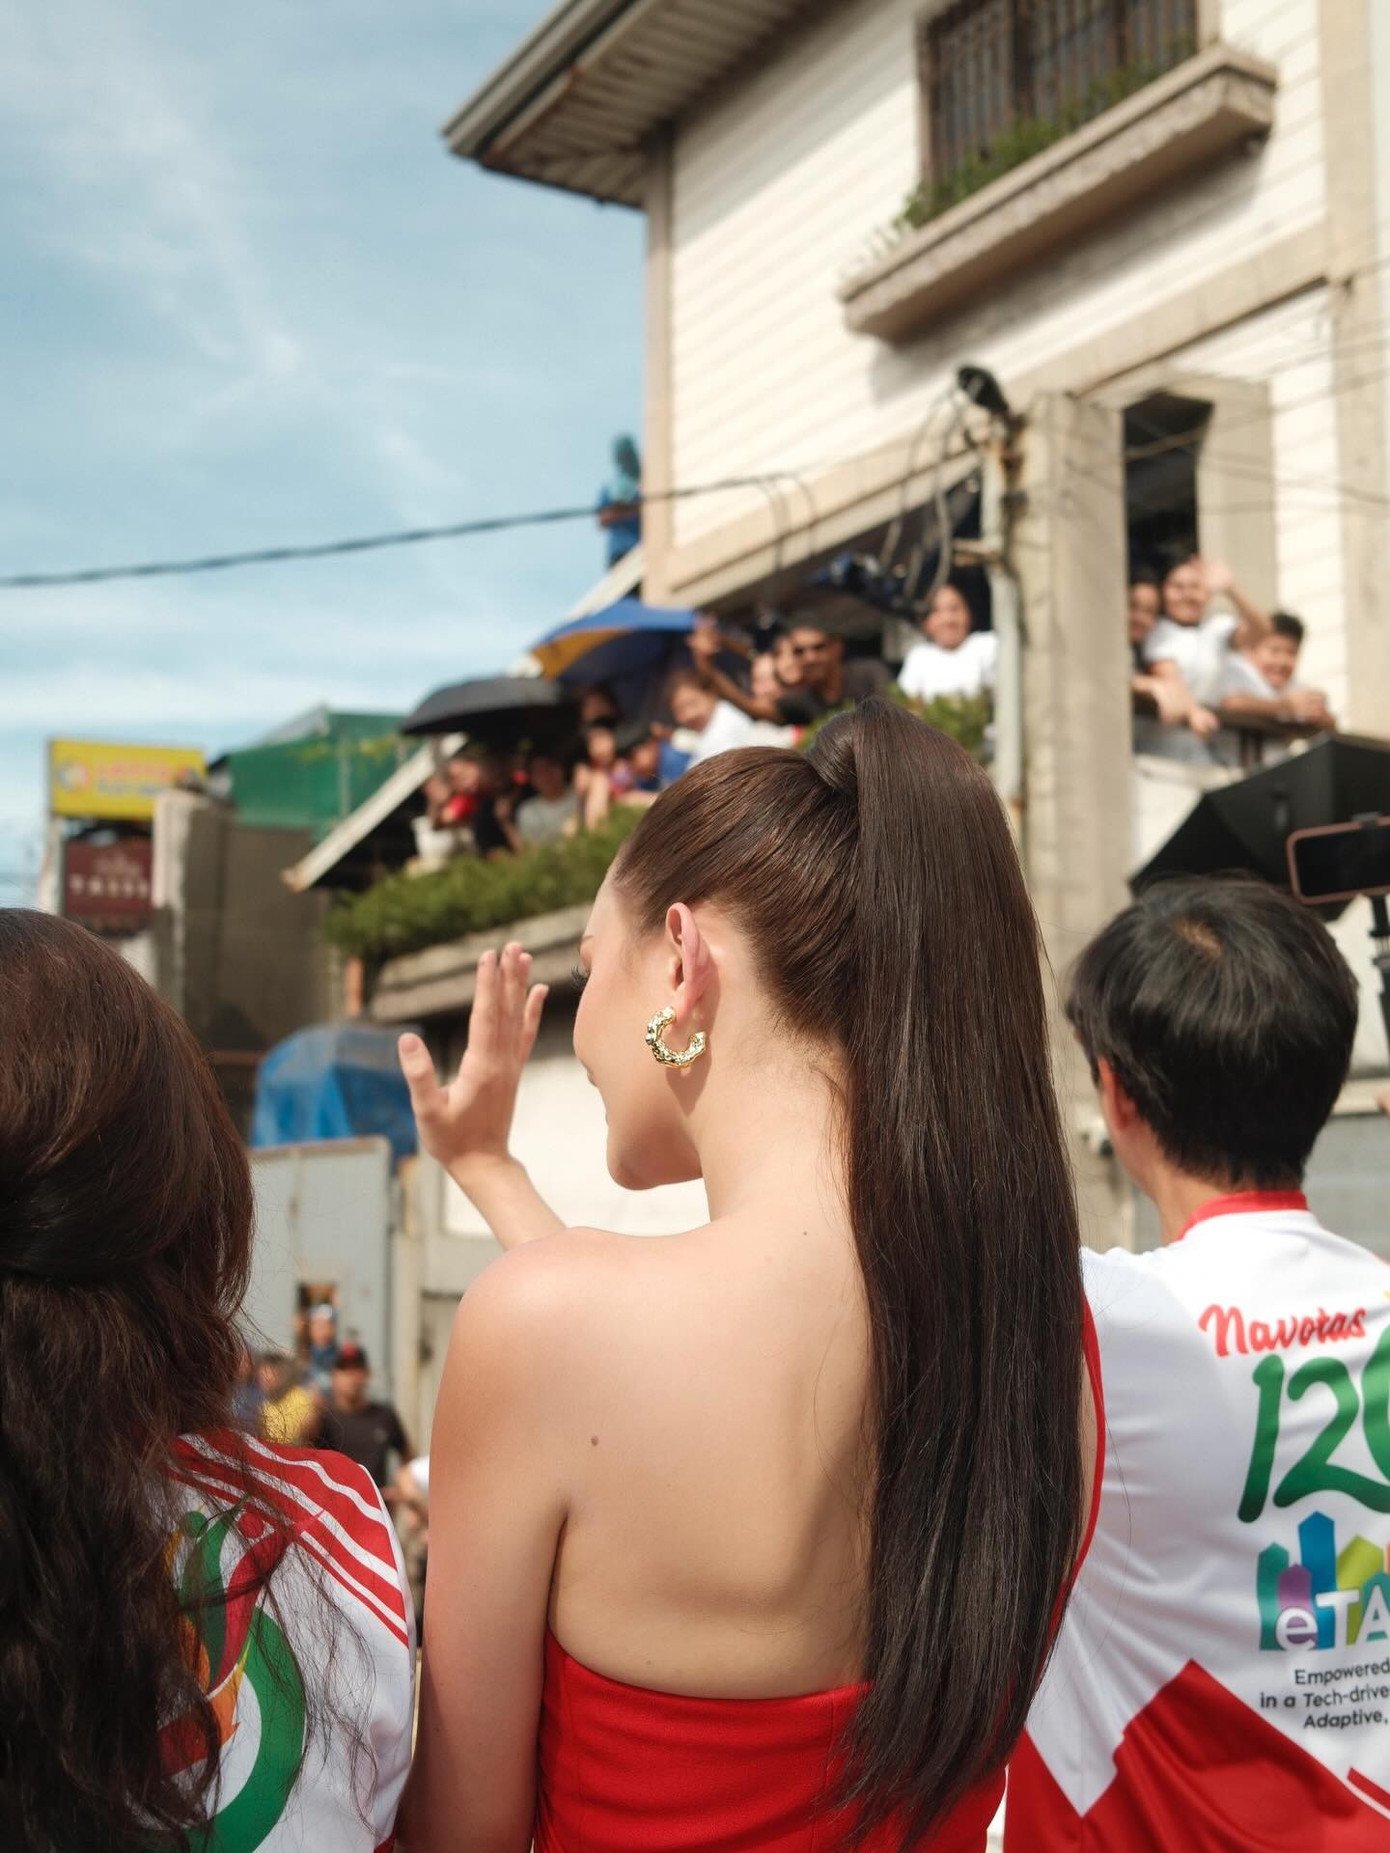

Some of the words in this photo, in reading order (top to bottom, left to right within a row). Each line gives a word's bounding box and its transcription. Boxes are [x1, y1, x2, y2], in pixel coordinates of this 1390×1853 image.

[1199, 1304, 1367, 1357] Navotas
[1295, 1657, 1390, 1685] Empowered
[1260, 1692, 1277, 1708] in
[1284, 1696, 1296, 1708] a
[1303, 1709, 1388, 1729] Adaptive,
